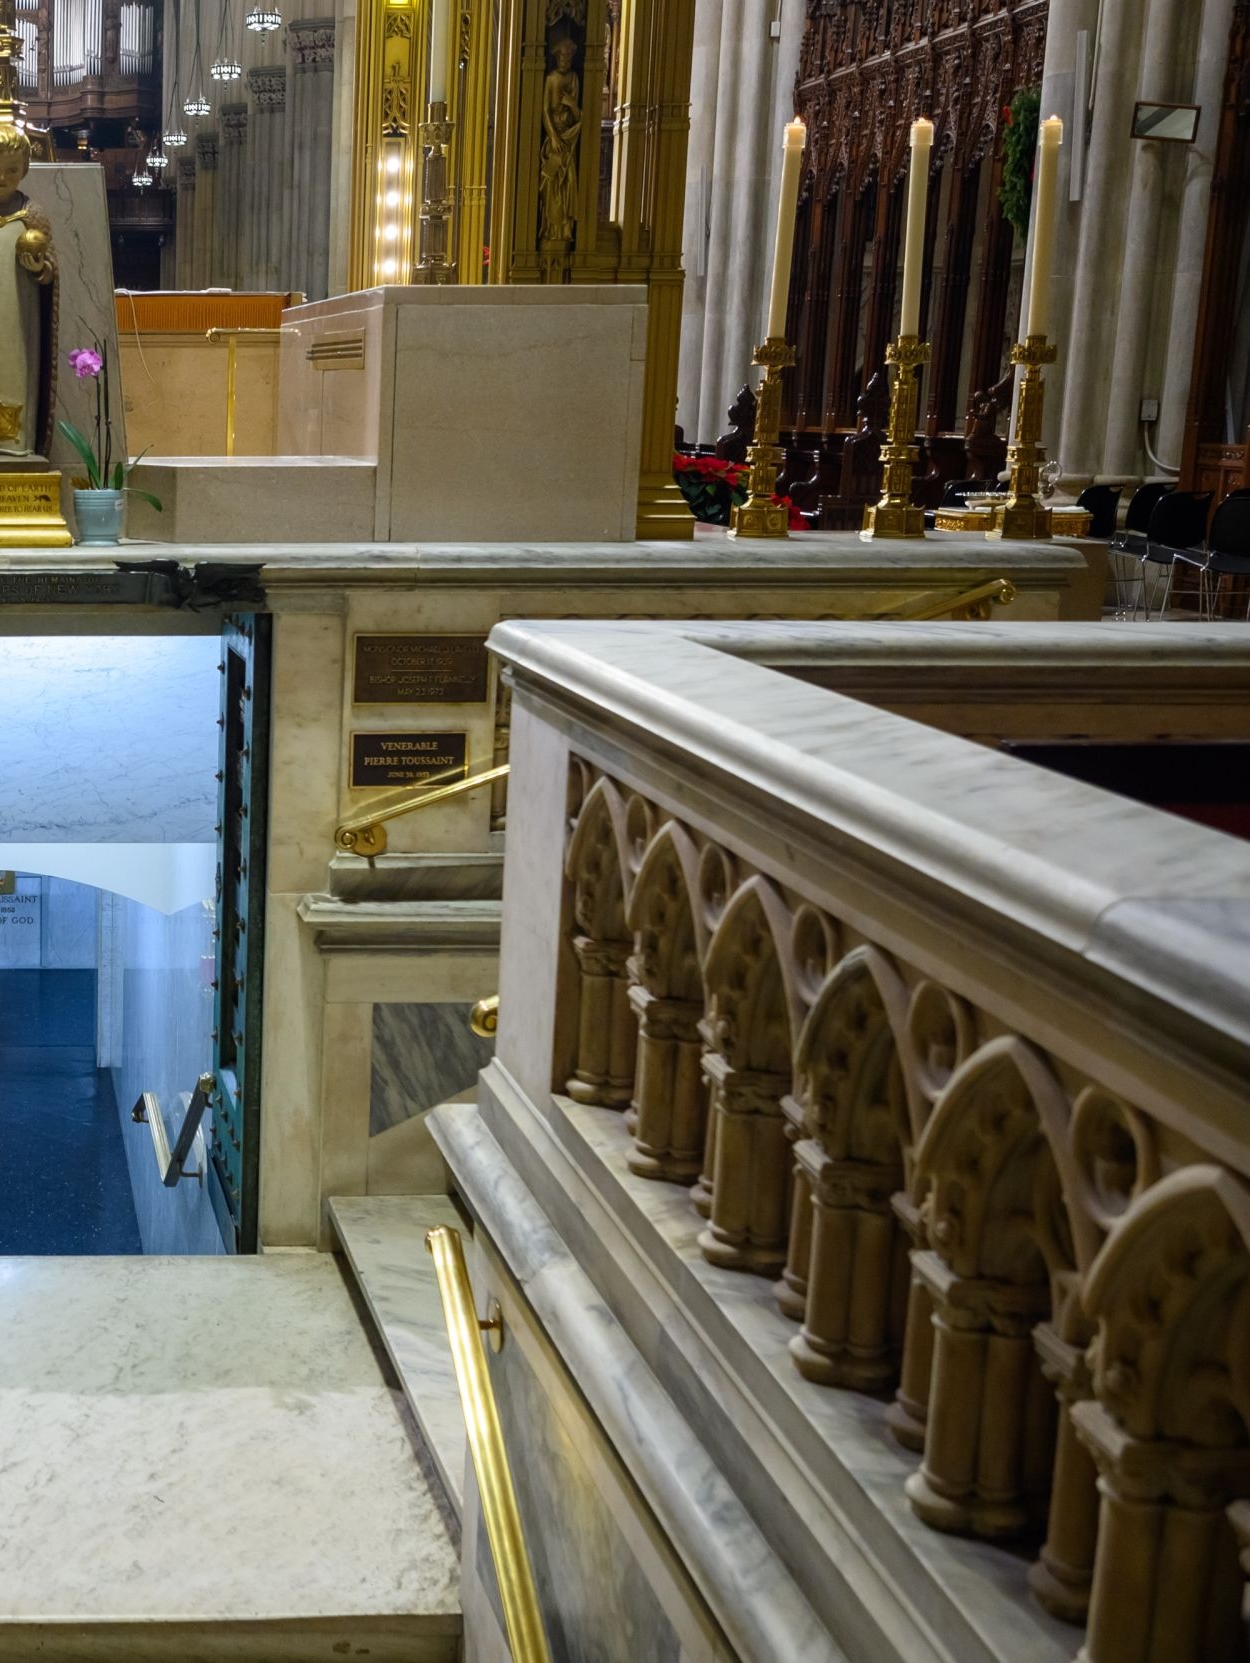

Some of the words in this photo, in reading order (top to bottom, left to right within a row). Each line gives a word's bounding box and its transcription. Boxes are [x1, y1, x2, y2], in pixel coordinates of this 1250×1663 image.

[7, 484, 19, 493] OF
[21, 484, 52, 493] EARTH
[13, 505, 23, 513] TO
[26, 585, 42, 595] OF
[47, 585, 79, 595] NEW
[86, 585, 120, 595] YORK
[390, 657, 426, 666] OCTOBER
[369, 675, 396, 684] BISHOP
[380, 742, 439, 751] VENERABLE
[364, 757, 399, 766] PIERRE
[400, 756, 455, 766] TOUSSAINT
[11, 916, 34, 925] GOD
